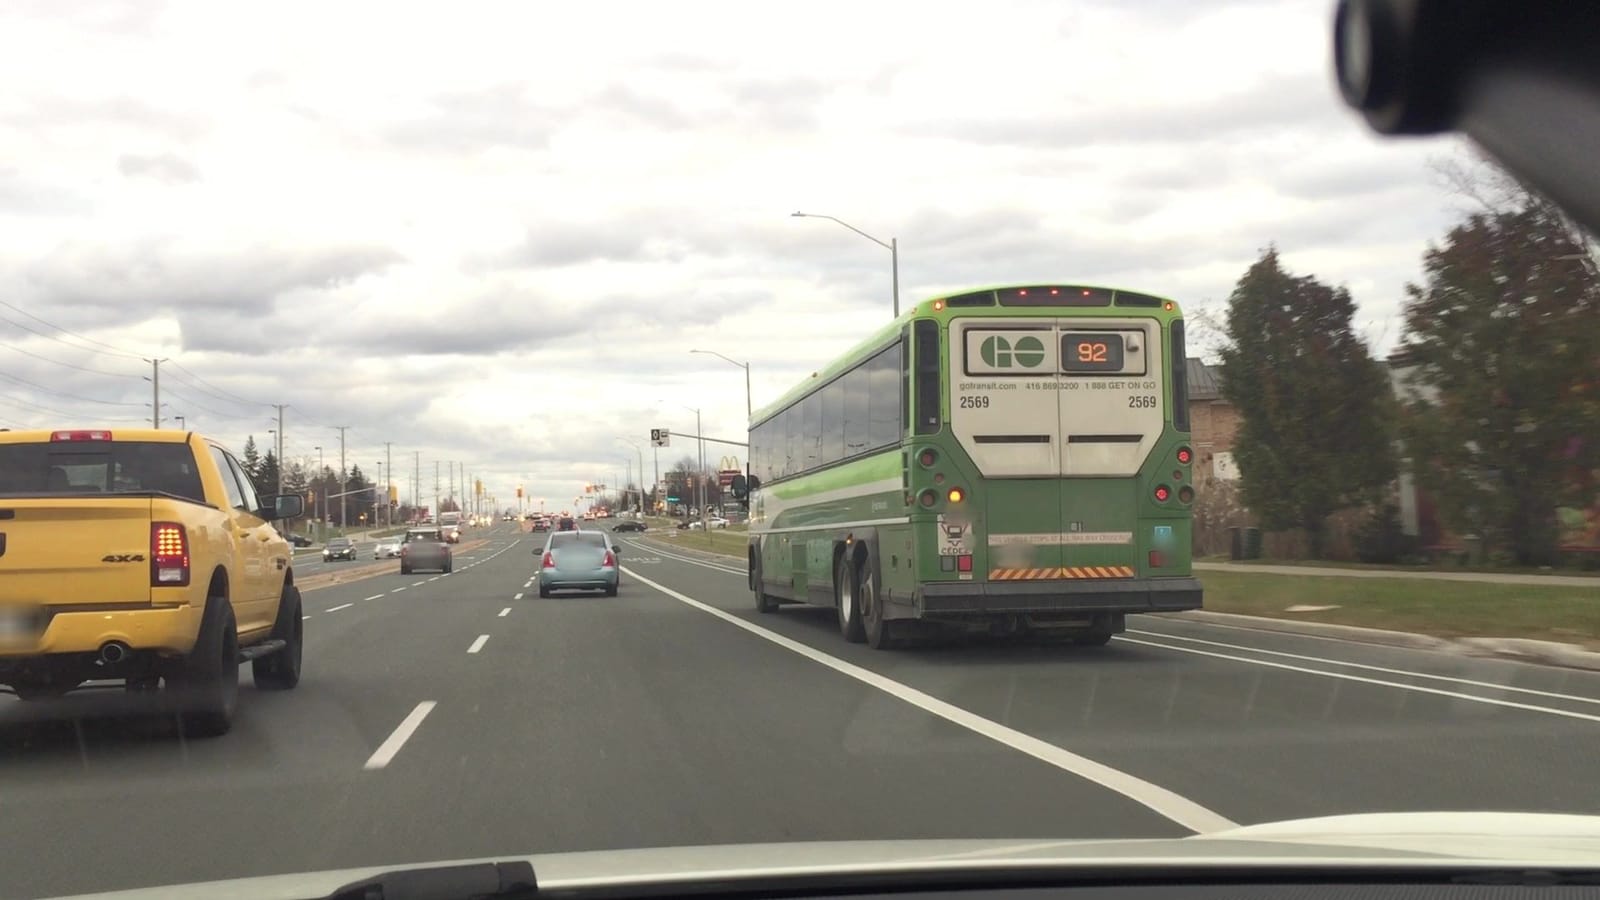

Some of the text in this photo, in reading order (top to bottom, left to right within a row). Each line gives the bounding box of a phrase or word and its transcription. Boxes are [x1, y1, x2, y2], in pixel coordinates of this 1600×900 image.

[1078, 343, 1107, 362] 92
[959, 382, 1017, 391] gotransit.com
[1025, 382, 1041, 390] 416
[1042, 382, 1058, 390] 869
[1091, 382, 1107, 390] 888
[1108, 382, 1126, 390] GET
[1127, 381, 1141, 390] ON
[1142, 381, 1156, 390] GO
[960, 395, 990, 409] 2569
[1128, 395, 1157, 409] 2569
